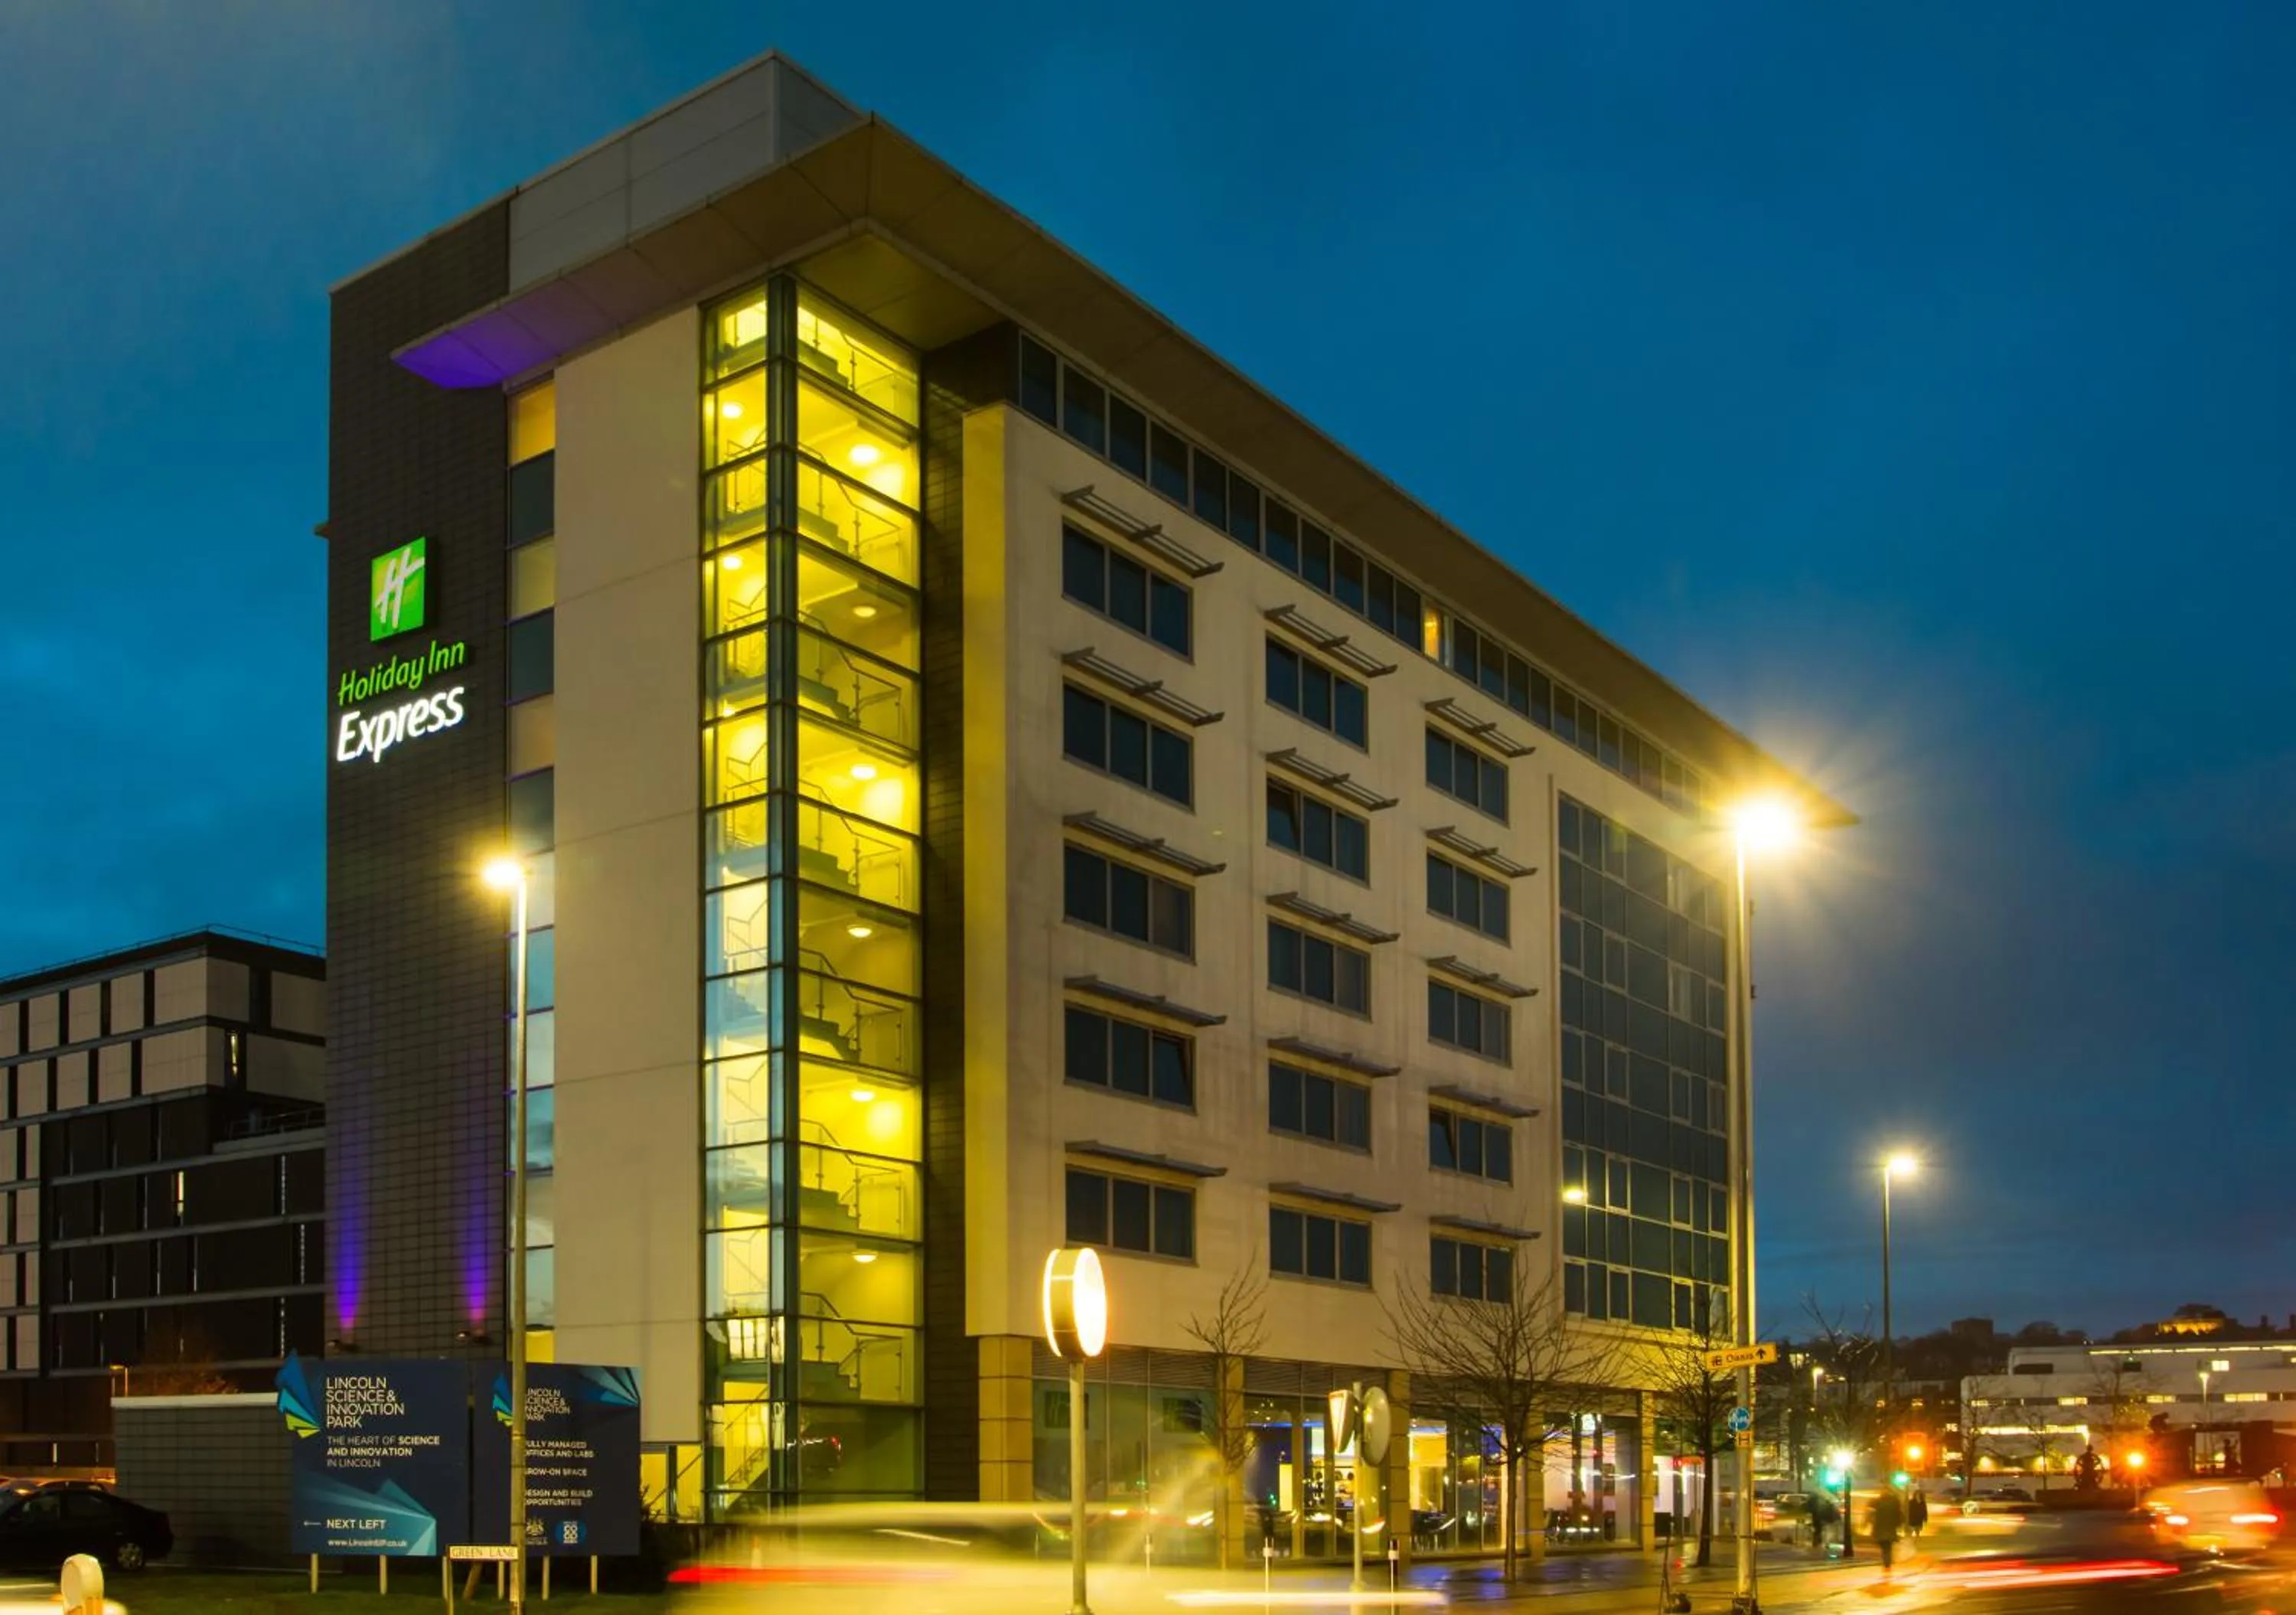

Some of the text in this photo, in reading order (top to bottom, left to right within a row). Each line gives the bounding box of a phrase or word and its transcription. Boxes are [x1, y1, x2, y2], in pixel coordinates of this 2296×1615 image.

[338, 640, 465, 707] Holiday Inn
[337, 686, 465, 764] Express
[326, 1376, 386, 1389] LINCOLN
[326, 1389, 396, 1402] SCIENCE &
[526, 1387, 561, 1397] INCOLN
[526, 1397, 559, 1406] CIENCE
[326, 1402, 406, 1415] INNOVATION
[526, 1405, 571, 1414] NNOVATION
[326, 1415, 362, 1428] PARK
[327, 1435, 441, 1445] THE HEART OF SCIENCE
[327, 1447, 413, 1457] AND INNOVATION
[327, 1458, 381, 1468] IN LINCOLN
[326, 1519, 387, 1529] NEXT LEFT
[452, 1547, 483, 1557] GREEN
